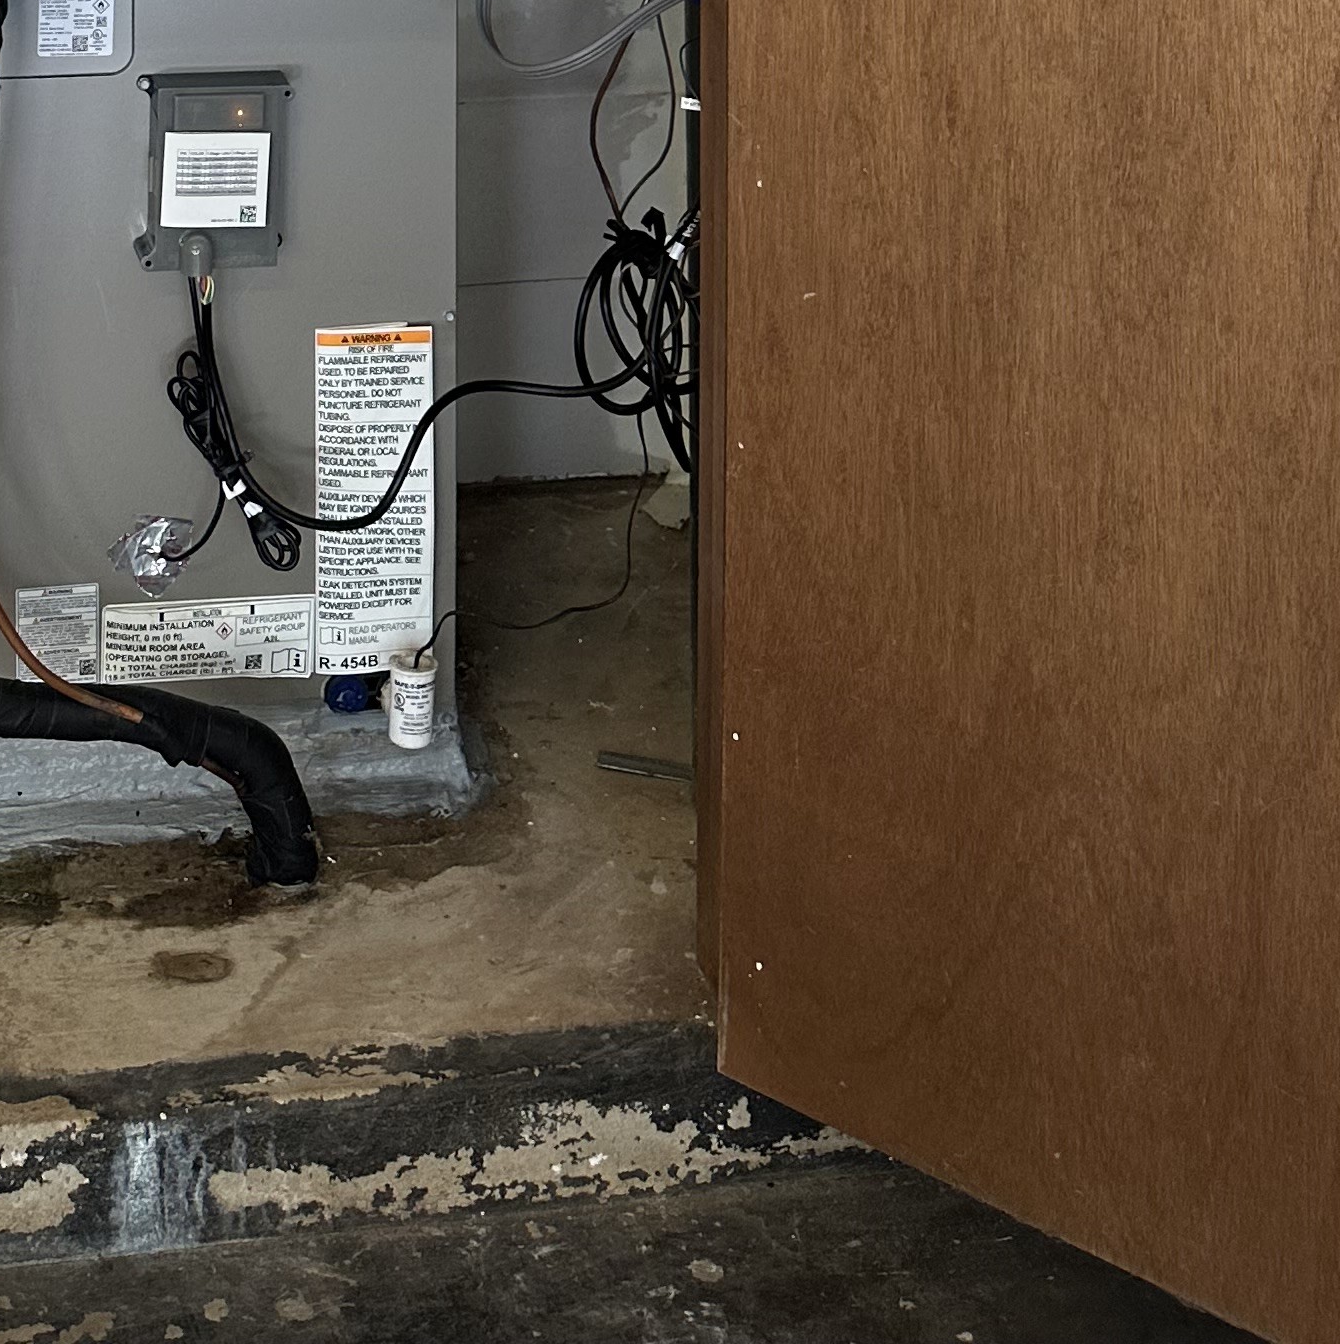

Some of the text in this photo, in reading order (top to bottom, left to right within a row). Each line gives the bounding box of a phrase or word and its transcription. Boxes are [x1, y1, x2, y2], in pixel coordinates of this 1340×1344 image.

[351, 333, 391, 343] WARNING
[318, 353, 428, 365] FLAMMABLE REFRIGERANT
[344, 367, 356, 377] TO
[357, 367, 368, 376] BE
[369, 365, 410, 375] REPAIRED
[318, 376, 425, 387] ONLY BY TRAINED SERVICE
[371, 388, 383, 398] DO
[385, 388, 403, 397] NOT
[318, 399, 422, 409] PUNCTURE REFRIGERANT
[318, 423, 411, 433] DISPOSE OF PROPERLY
[318, 435, 399, 444] ACCORDANCE WITH
[318, 445, 400, 456] FEDERAL OR LOCAL
[318, 467, 370, 478] FLAMMABLE
[318, 492, 426, 503] AUXILIARY WHICH
[318, 502, 427, 514] MAY BE SOURCES
[397, 527, 426, 536] OTHER
[319, 534, 340, 544] THAN
[341, 537, 384, 545] AUXILIARY
[319, 545, 346, 555] LISTED
[348, 547, 365, 555] FOR
[366, 547, 383, 555] USE
[407, 547, 423, 555] THE
[318, 556, 354, 566] SPECIFIC
[405, 556, 421, 564] SEE
[318, 578, 422, 589] LEAK DETECTION SYSTEM
[365, 589, 384, 598] UNIT
[385, 588, 408, 596] MUST
[409, 587, 421, 595] BE
[318, 598, 412, 610] POWERED EXCEPT FOR
[242, 612, 303, 625] REFRIGERANT
[106, 620, 215, 631] MINIMUM INSTALLATION
[239, 622, 306, 636] SAFETY GROUP
[348, 622, 416, 634] READ OPERATORS
[348, 635, 379, 645] MANUAL
[106, 642, 205, 652] MINIMUM ROOM AREA
[105, 653, 162, 662] (OPERATING
[340, 655, 378, 669] 454B
[128, 664, 156, 672] TOTAL
[160, 662, 199, 670] CHARGE
[160, 668, 198, 677] CHARGE
